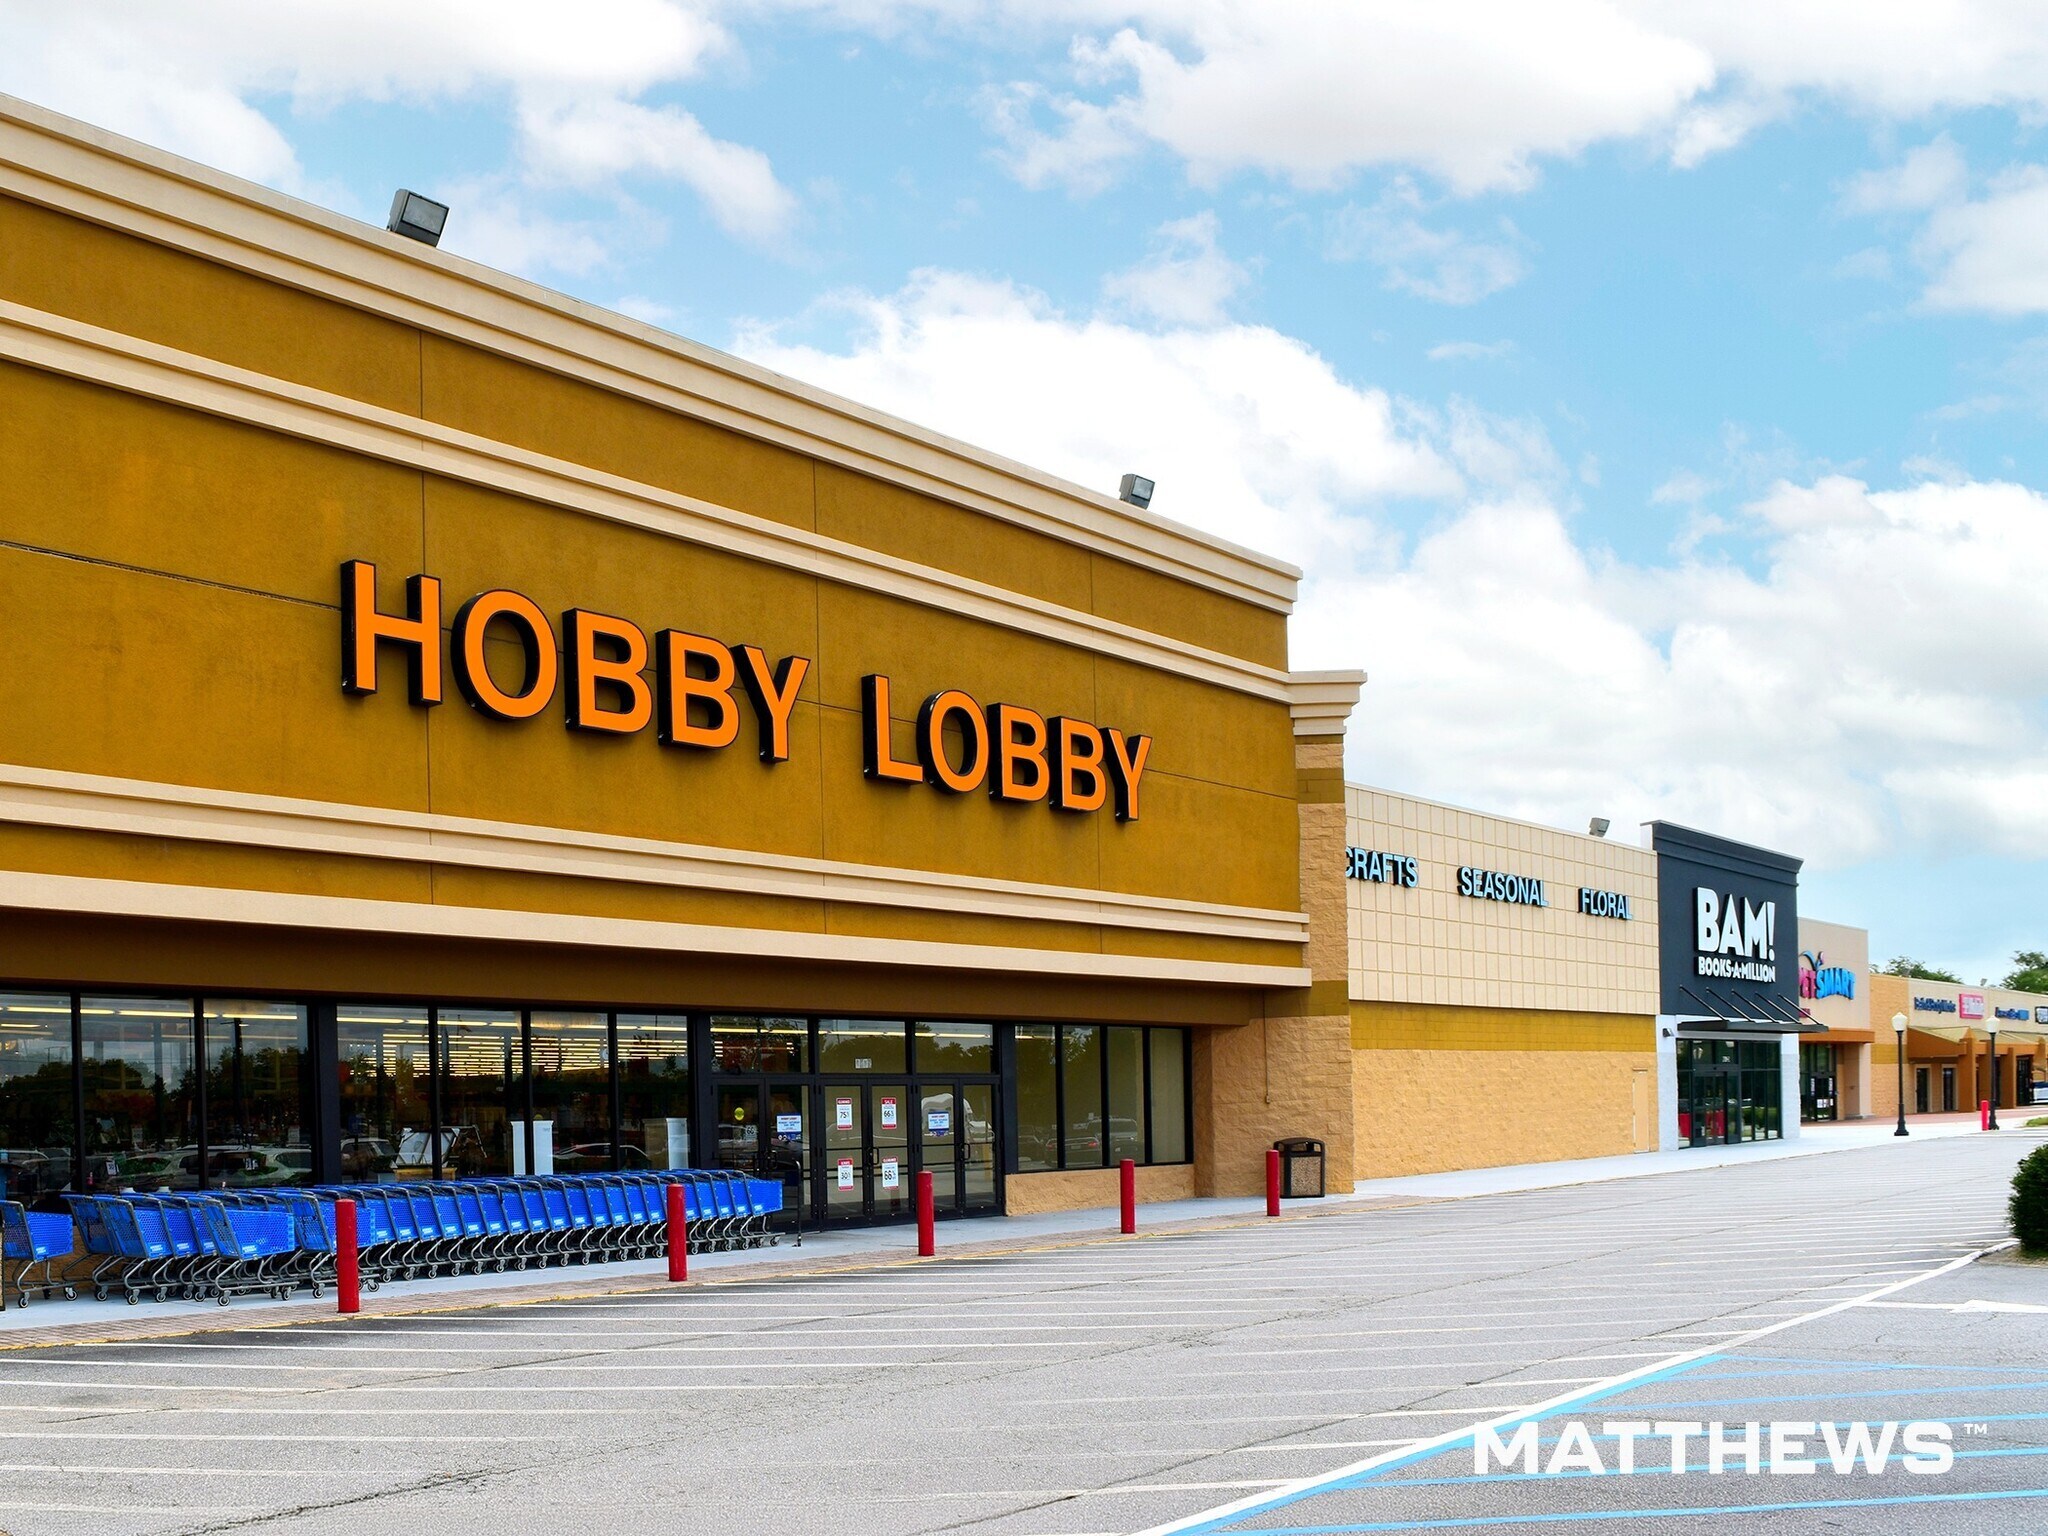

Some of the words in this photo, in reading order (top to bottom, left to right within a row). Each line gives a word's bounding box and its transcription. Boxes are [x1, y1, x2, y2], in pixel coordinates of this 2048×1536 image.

[341, 559, 810, 763] HOBBY
[861, 674, 1152, 822] LOBBY
[1458, 866, 1549, 907] SEASONAL
[1579, 888, 1632, 920] FLORAL
[1694, 887, 1776, 961] BAM!
